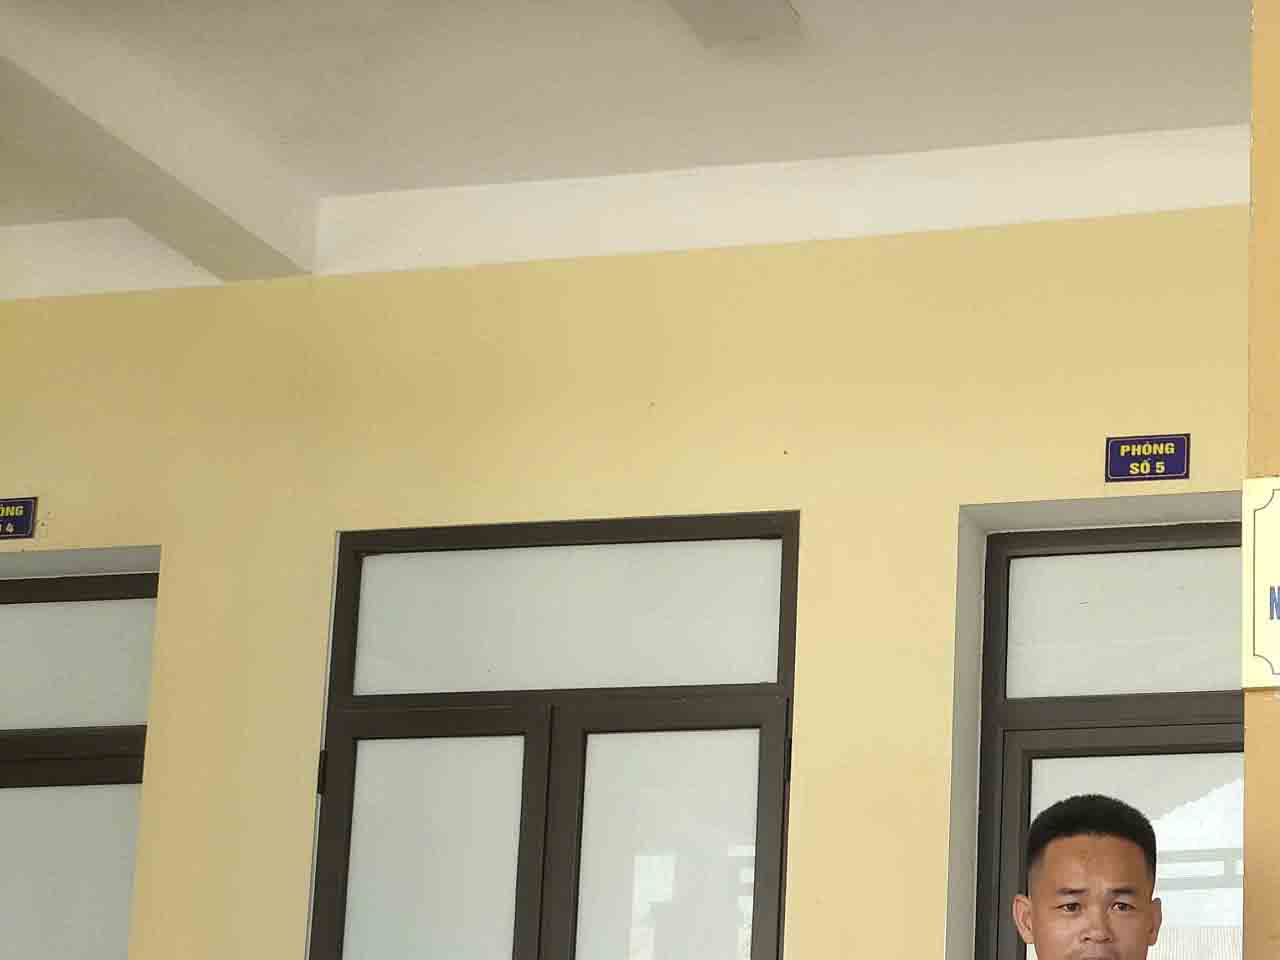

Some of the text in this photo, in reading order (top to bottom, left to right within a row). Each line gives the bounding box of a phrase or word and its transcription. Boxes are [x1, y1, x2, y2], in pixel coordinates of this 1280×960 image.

[1119, 441, 1175, 457] PHÒNG
[1129, 457, 1165, 474] SỐ 5
